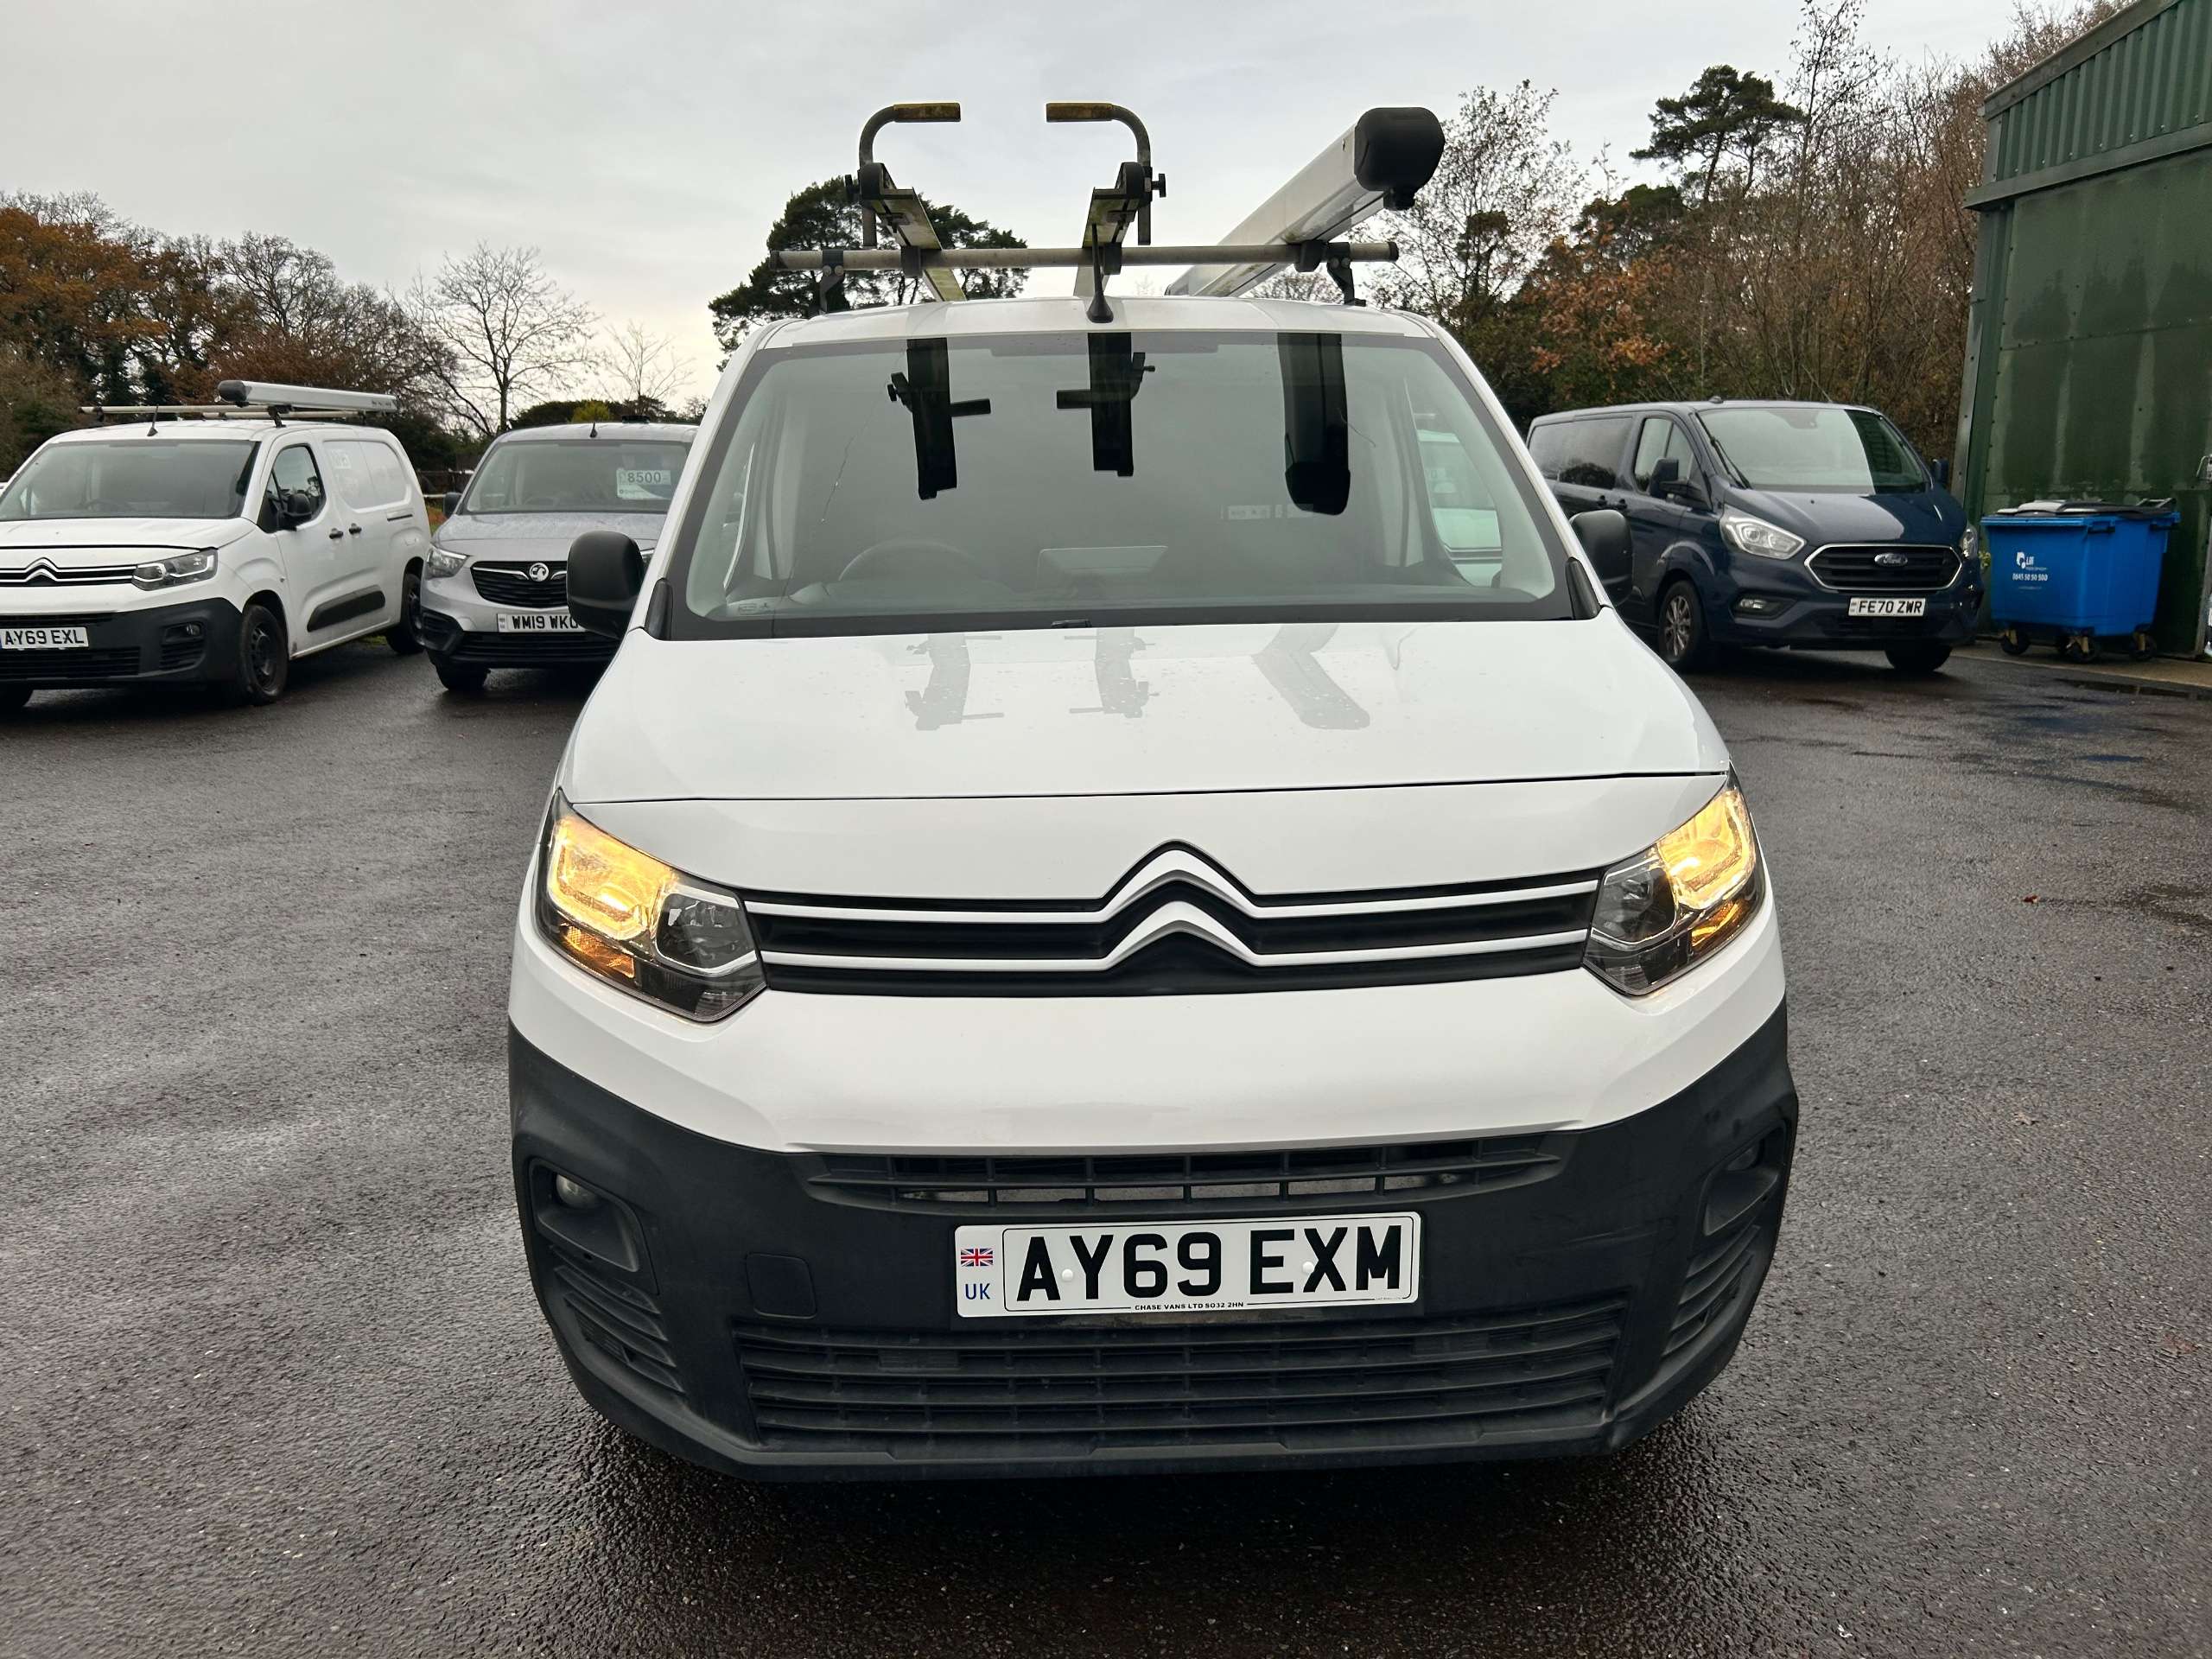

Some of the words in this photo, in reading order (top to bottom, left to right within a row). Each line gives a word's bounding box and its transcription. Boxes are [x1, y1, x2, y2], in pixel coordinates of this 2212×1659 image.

[1859, 601, 1894, 613] FE70
[1897, 601, 1923, 613] ZWR
[512, 615, 545, 629] WM19
[4, 630, 48, 645] AY69
[50, 629, 85, 644] EXL
[1016, 1231, 1222, 1301] AY69
[1249, 1224, 1402, 1295] EXM
[965, 1282, 991, 1300] UK
